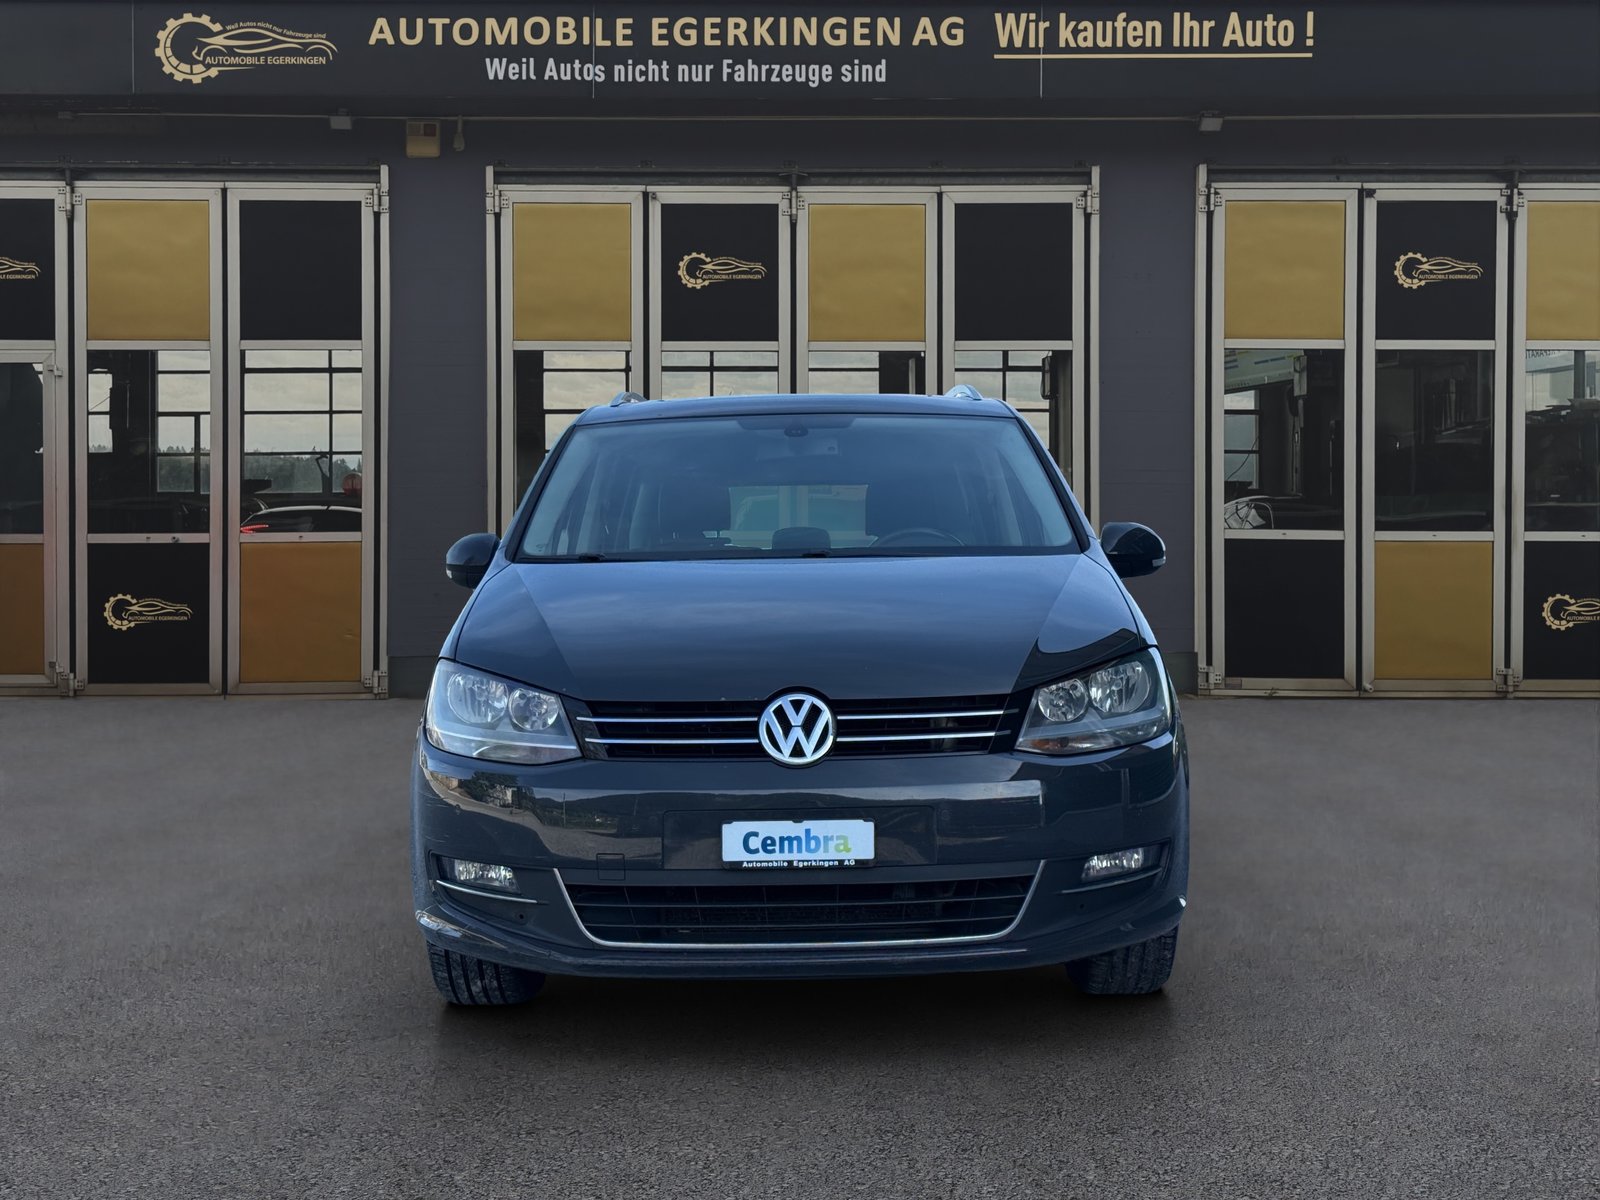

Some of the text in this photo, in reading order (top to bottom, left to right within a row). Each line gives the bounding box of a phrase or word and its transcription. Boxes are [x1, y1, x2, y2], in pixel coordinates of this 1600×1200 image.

[225, 22, 239, 31] Weil
[257, 21, 273, 30] nicht
[272, 25, 283, 34] nur
[283, 29, 313, 39] Fahrzeuge
[368, 16, 965, 47] AUTOMOBILE EGERKINGEN AG
[994, 12, 1050, 48] Wir
[1058, 12, 1163, 48] kaufen
[1173, 11, 1216, 48] Ihr
[1222, 11, 1295, 47] Auto
[205, 56, 327, 65] AUTOMOBILE EGERKINGEN
[485, 57, 887, 88] Weil Autos nicht nur Fahrzeuge sind
[742, 829, 852, 855] Cembra
[742, 860, 788, 868] Automobile
[793, 859, 839, 868] Egerkingen
